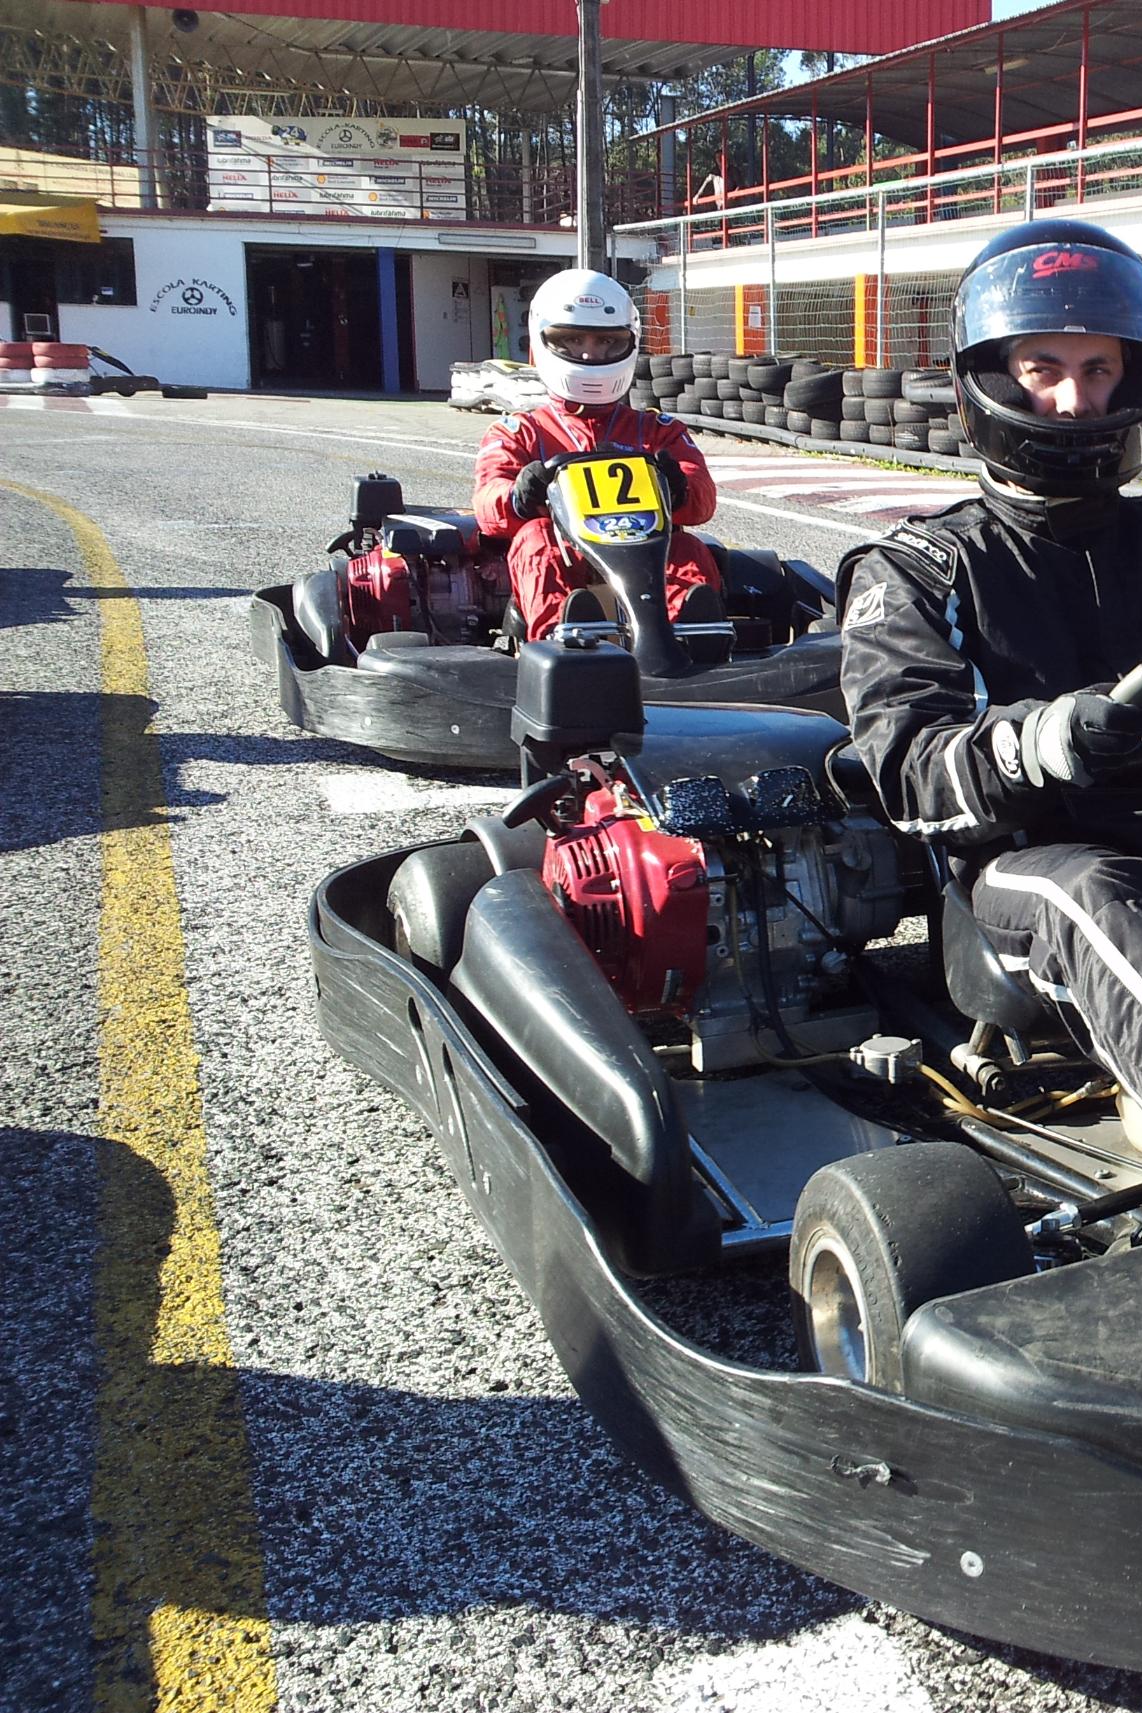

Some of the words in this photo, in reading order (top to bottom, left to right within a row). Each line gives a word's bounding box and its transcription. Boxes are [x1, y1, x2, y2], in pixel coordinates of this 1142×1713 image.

[345, 122, 376, 149] KARTING
[1032, 250, 1098, 272] CMS
[149, 278, 186, 313] ESCOLA
[192, 277, 238, 317] KARTING
[171, 306, 218, 315] EUROINDY
[583, 462, 640, 509] 12
[604, 517, 632, 531] 24
